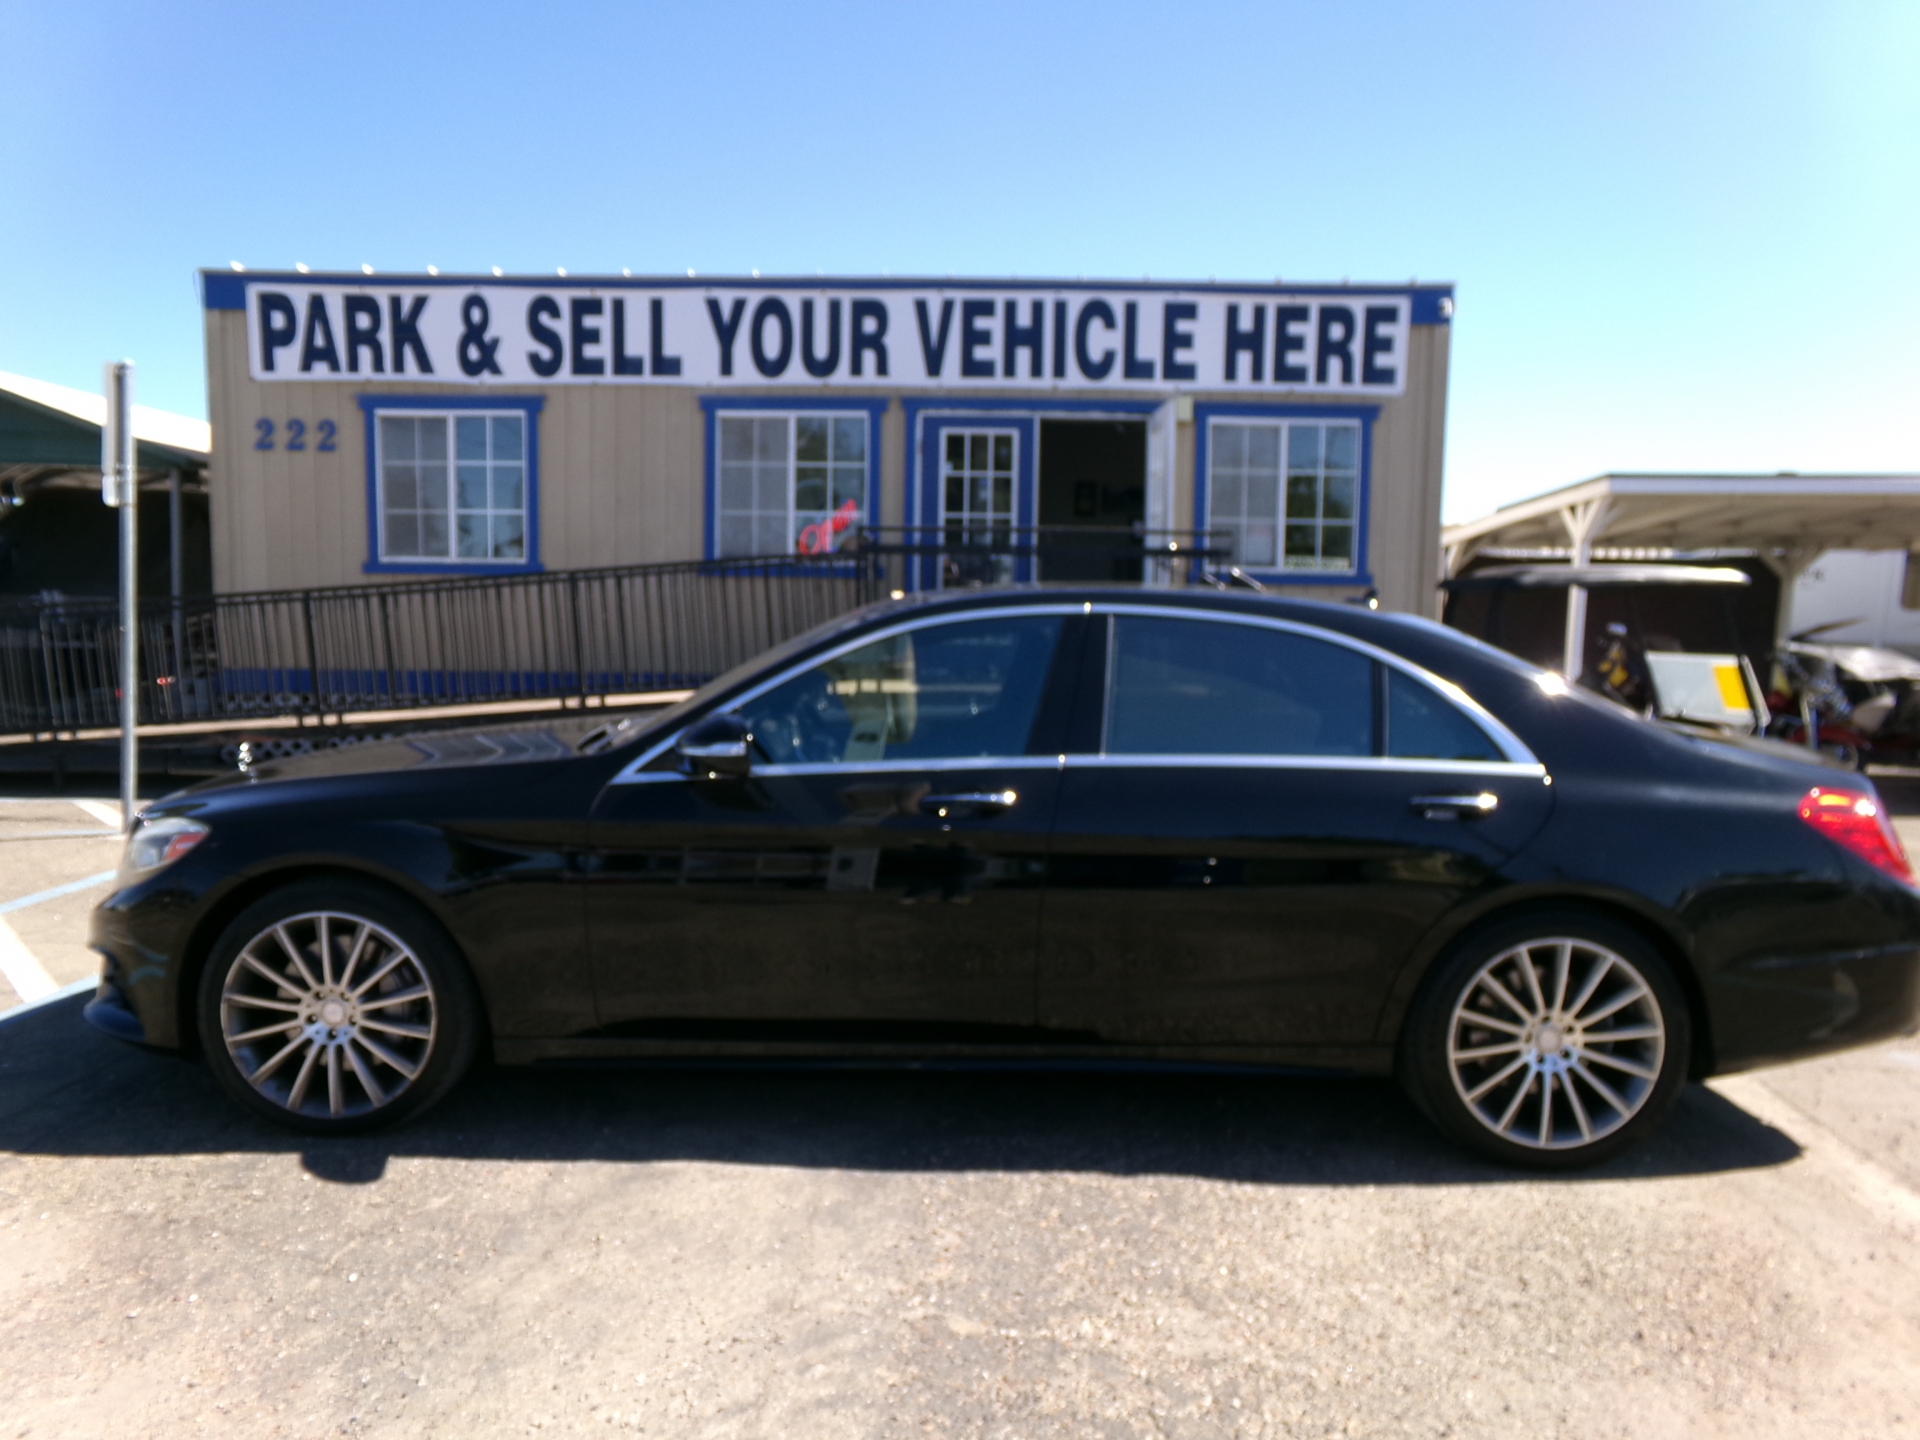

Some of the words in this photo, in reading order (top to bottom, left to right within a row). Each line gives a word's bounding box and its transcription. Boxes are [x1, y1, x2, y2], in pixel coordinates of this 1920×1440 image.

[257, 291, 435, 375] PARK
[457, 293, 503, 378] &
[526, 294, 682, 378] SELL
[705, 296, 889, 380] YOUR
[914, 298, 1198, 382] VEHICLE
[1224, 303, 1399, 386] HERE
[253, 417, 339, 453] 222
